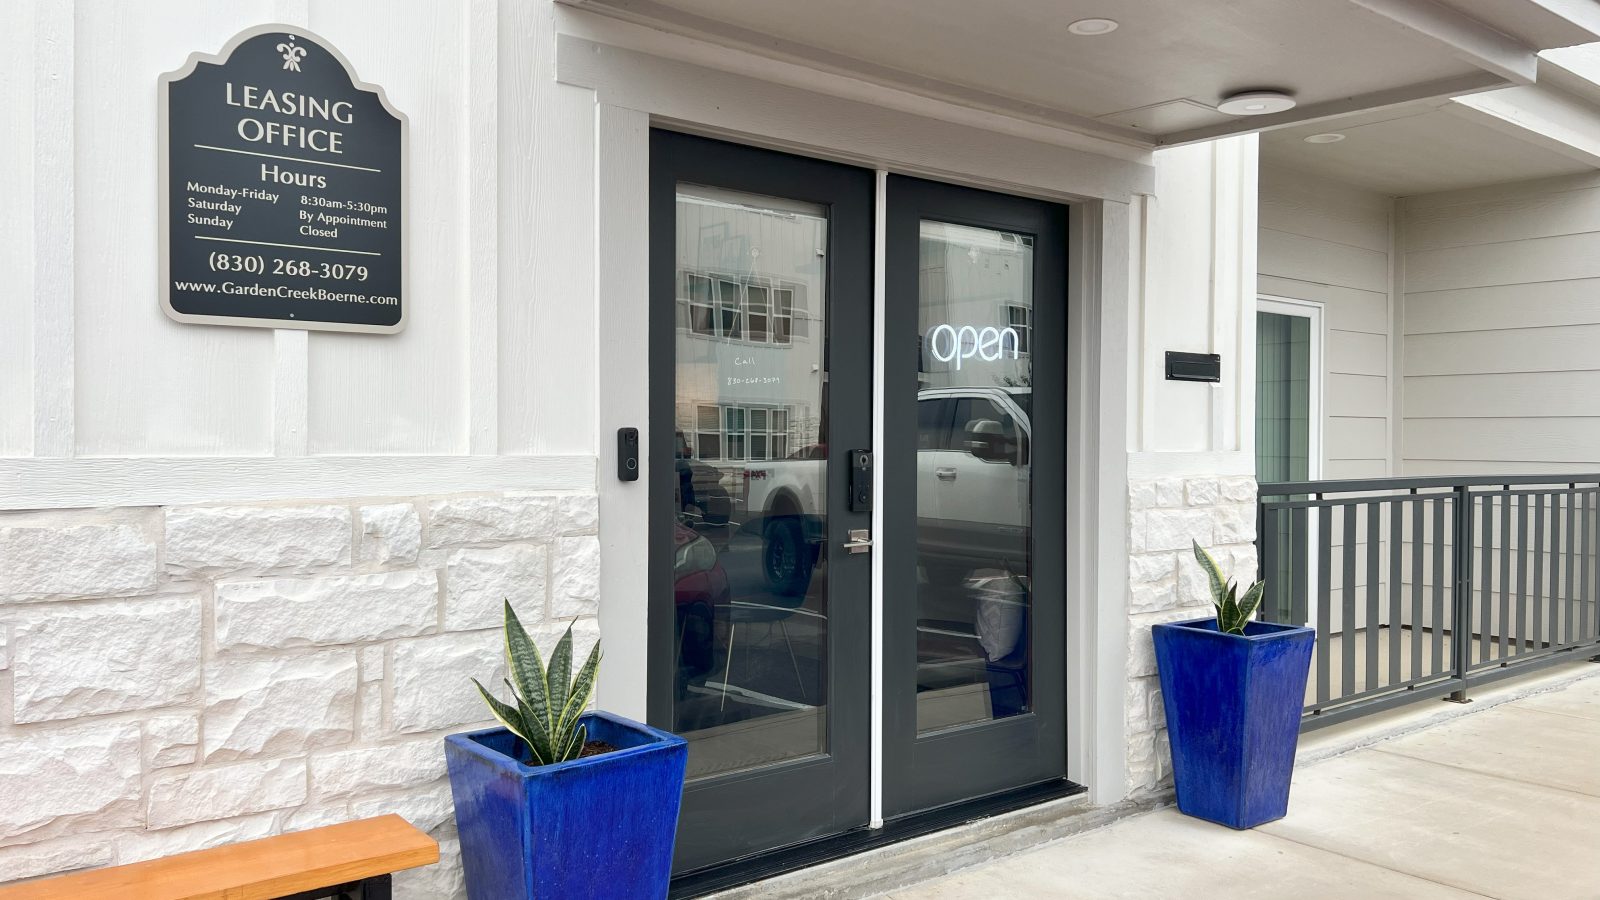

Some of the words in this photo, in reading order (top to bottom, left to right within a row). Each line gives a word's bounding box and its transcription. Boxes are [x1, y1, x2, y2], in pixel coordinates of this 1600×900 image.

[226, 82, 353, 124] LEASING
[237, 118, 343, 154] OFFICE
[260, 164, 326, 189] Hours
[187, 181, 279, 204] Monday-Friday
[300, 194, 388, 215] 8:30am-5:30pm
[188, 197, 242, 215] Saturday
[299, 210, 314, 222] By
[318, 212, 388, 229] Appointment
[188, 212, 234, 230] Sunday
[300, 225, 338, 238] Closed
[208, 251, 265, 275] (830)
[272, 258, 369, 281] 268-3079
[175, 279, 398, 306] www.GardenCreekBoerne.com
[734, 356, 756, 366] Call
